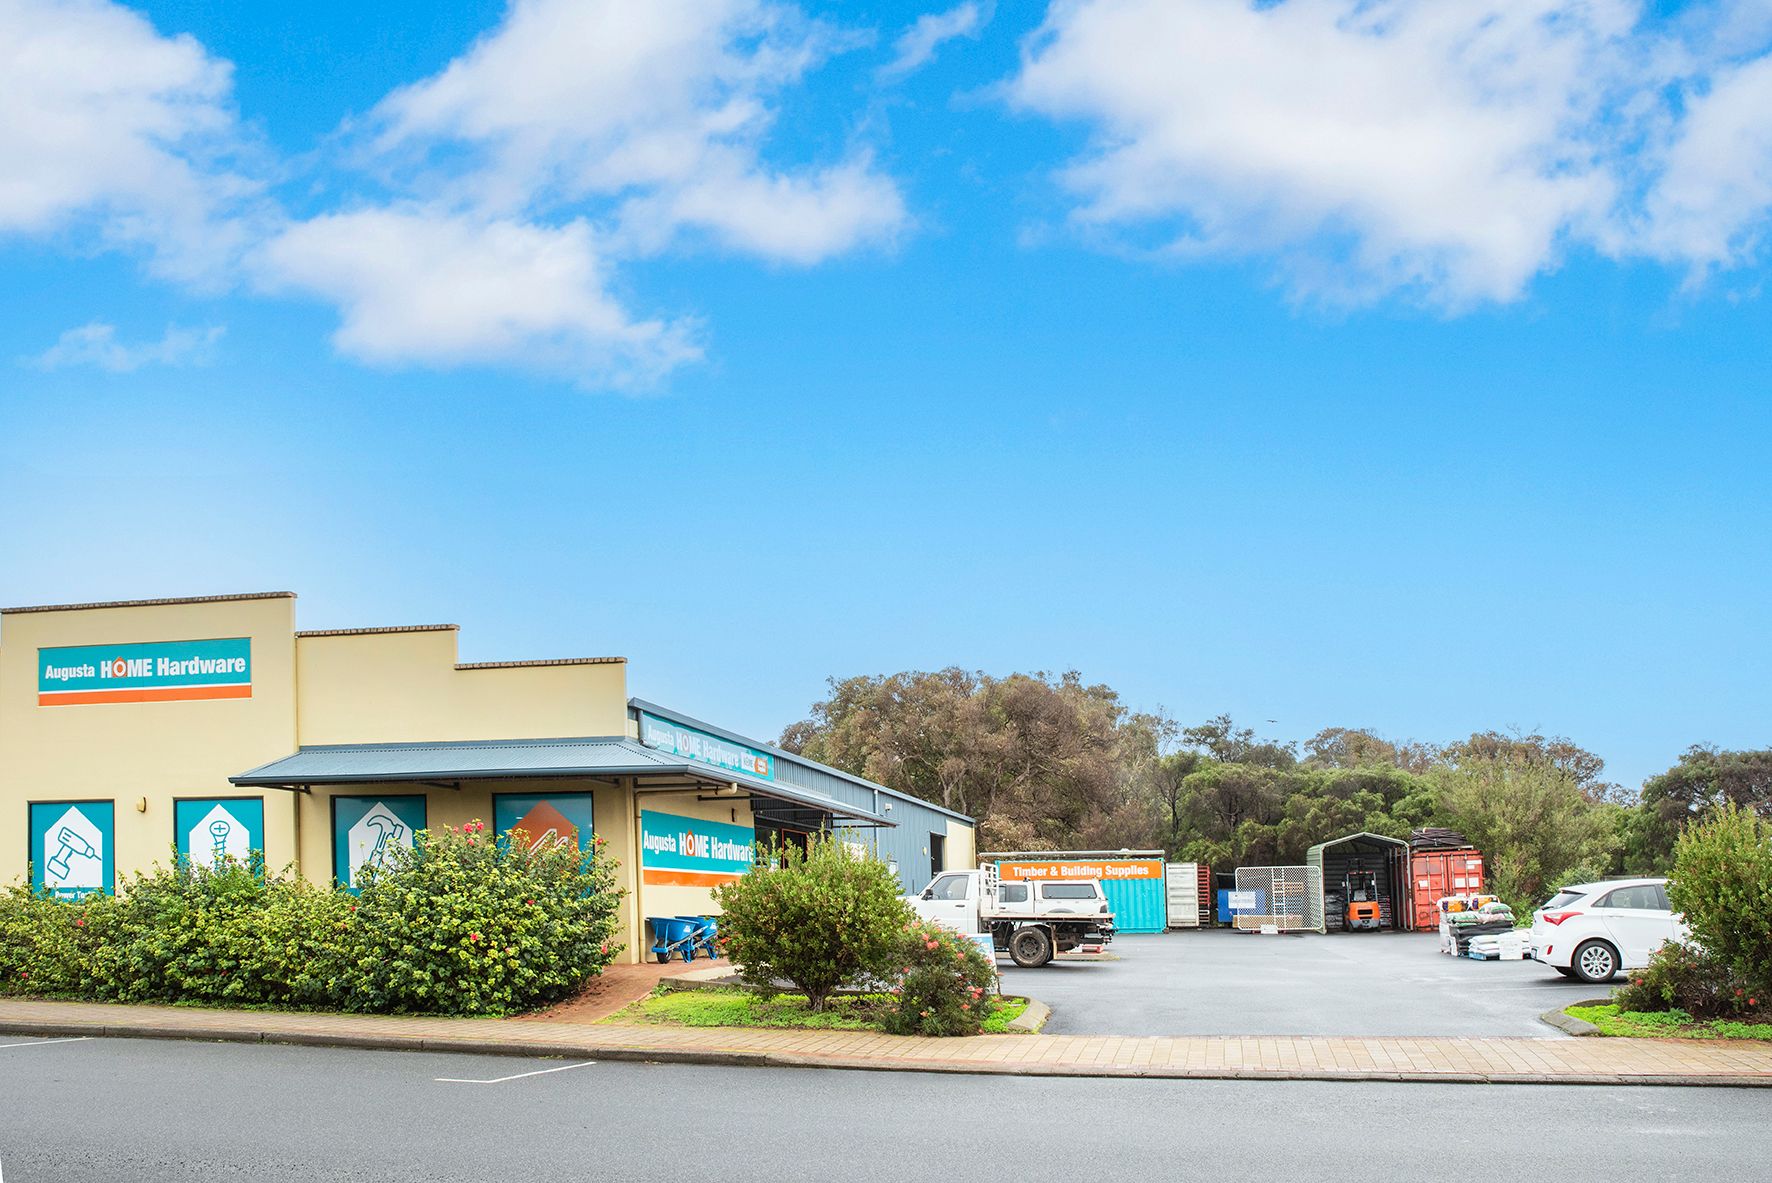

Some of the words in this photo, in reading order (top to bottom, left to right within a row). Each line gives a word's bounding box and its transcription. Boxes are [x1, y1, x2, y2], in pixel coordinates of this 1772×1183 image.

[45, 664, 95, 682] Augusta
[101, 658, 153, 679] HOME
[157, 656, 246, 677] Hardware
[647, 725, 675, 746] Augusta
[676, 731, 701, 756] HOME
[702, 740, 739, 768] Hardware
[643, 830, 677, 855] Augusta
[678, 832, 709, 859] HOME
[1013, 866, 1048, 877] Timber
[1050, 866, 1059, 877] &
[1061, 866, 1103, 878] Building
[1105, 865, 1149, 877] Supplies
